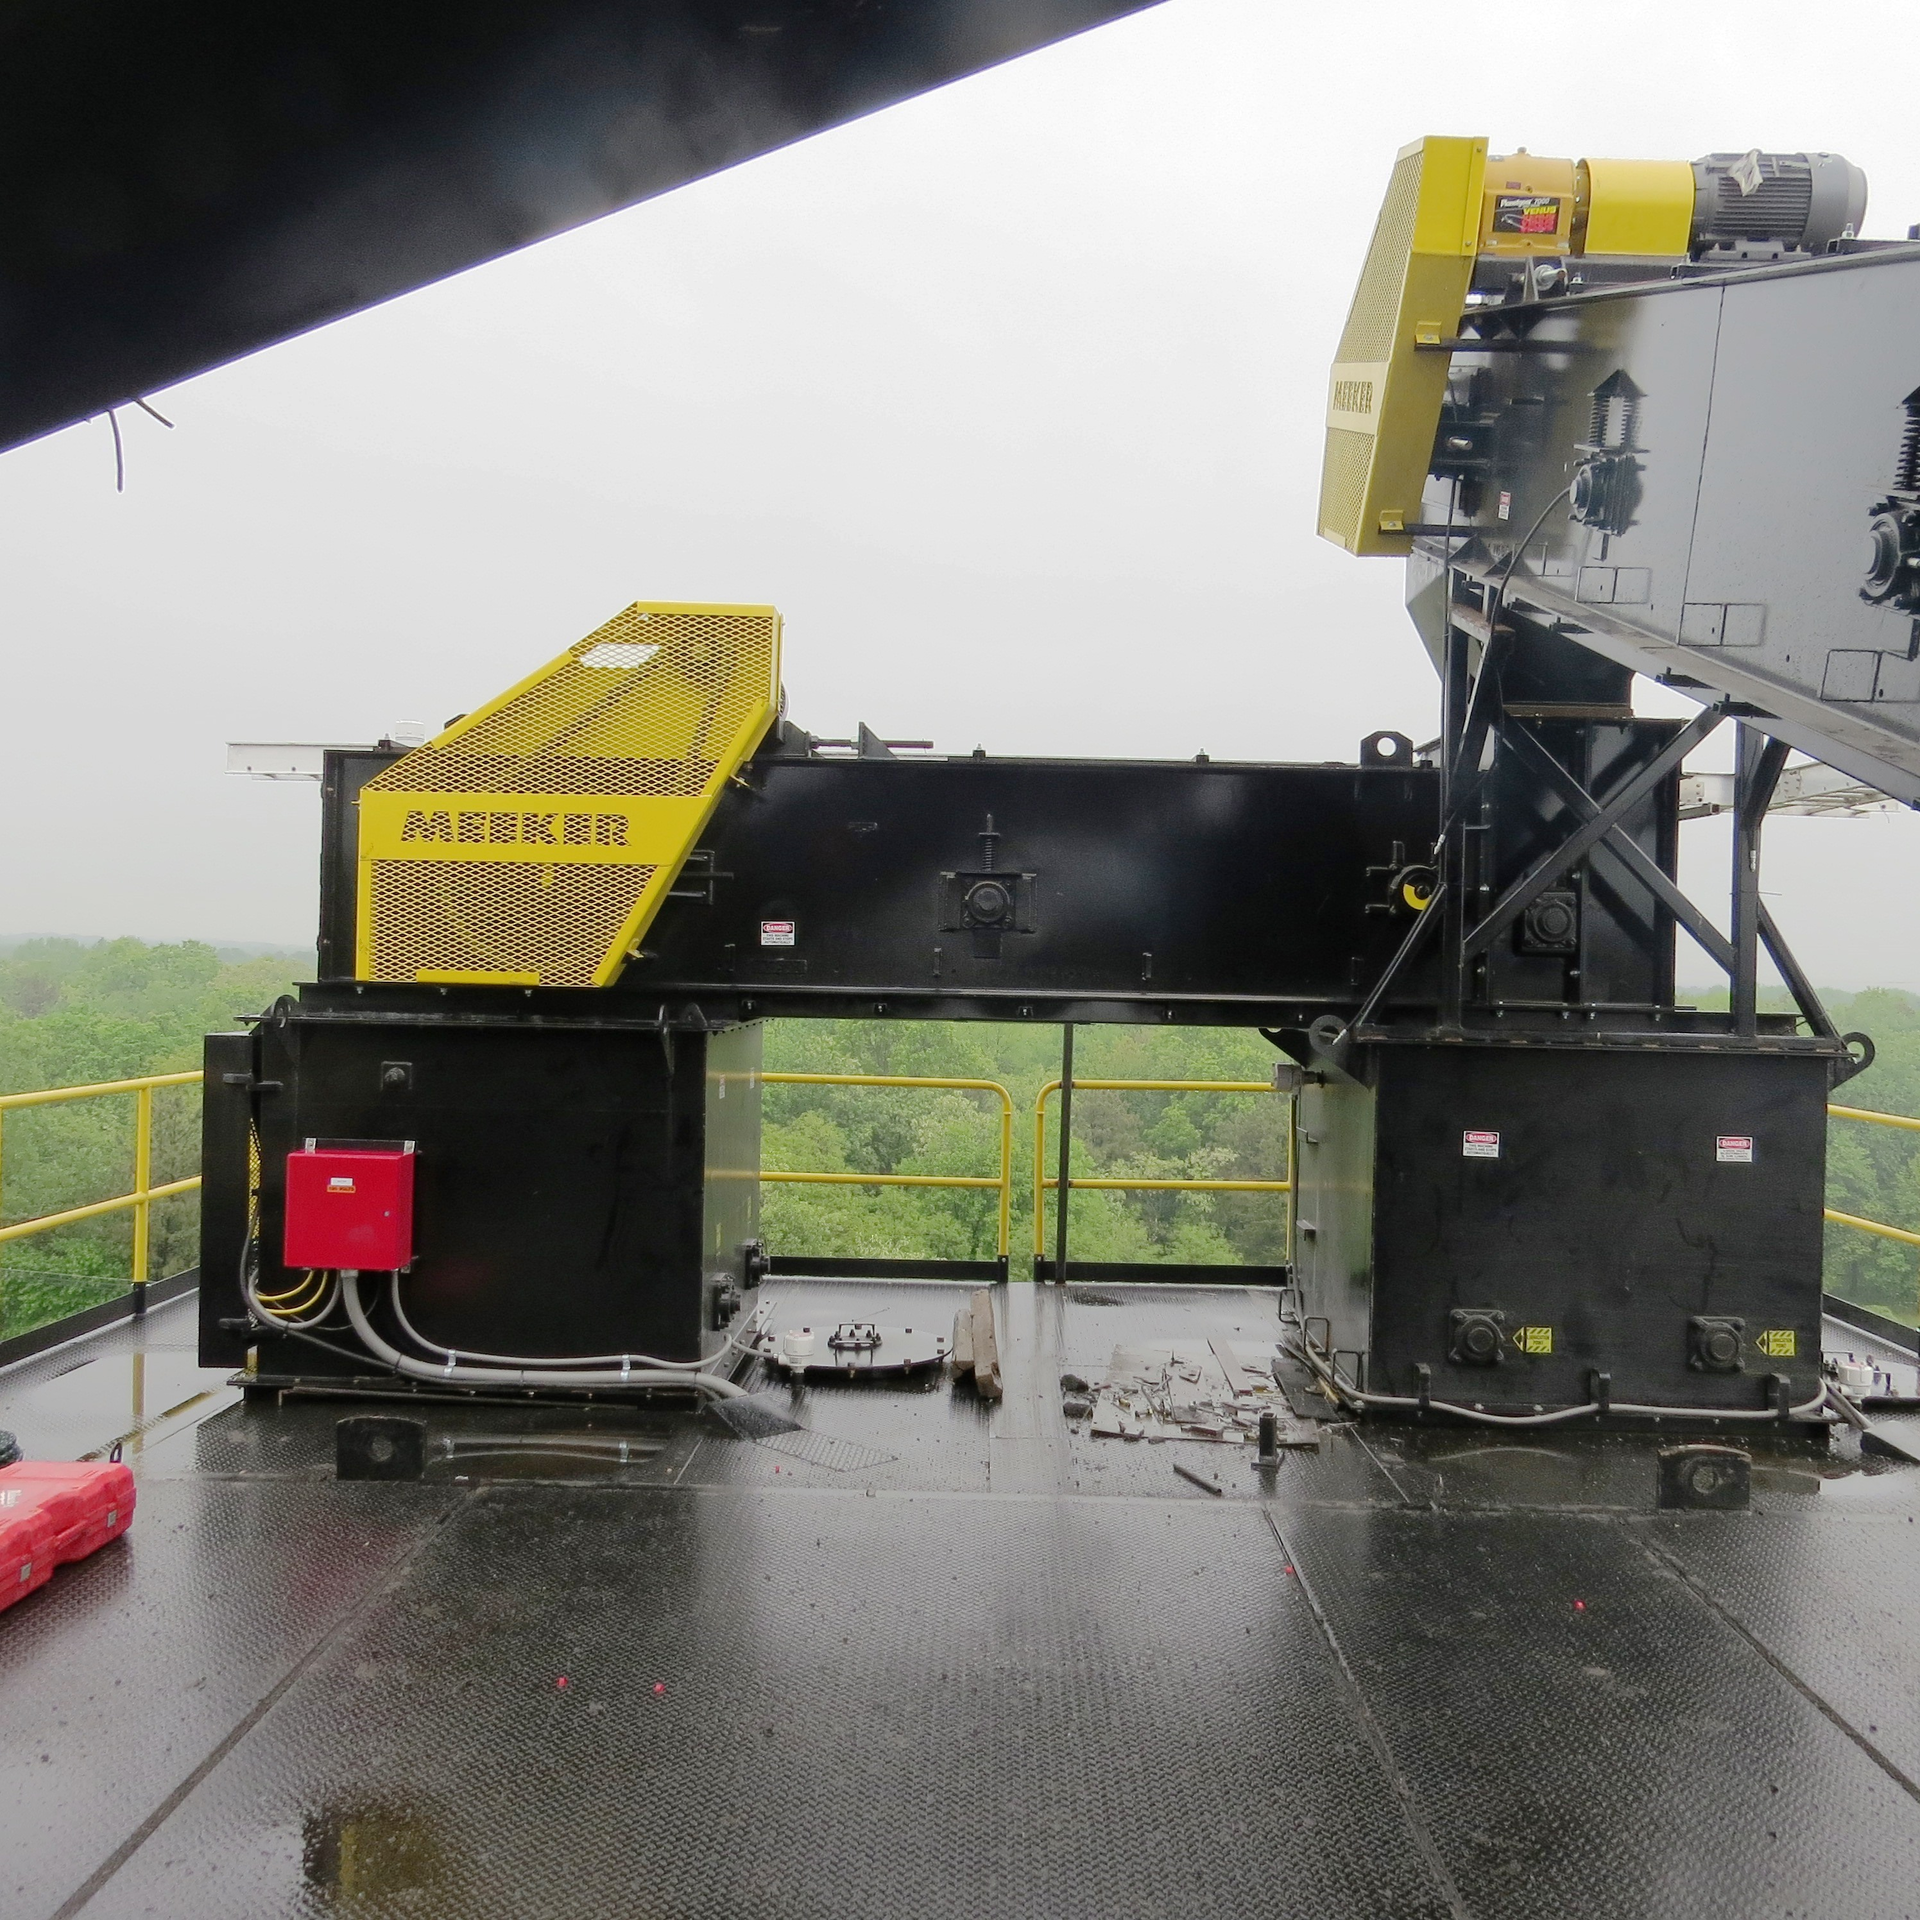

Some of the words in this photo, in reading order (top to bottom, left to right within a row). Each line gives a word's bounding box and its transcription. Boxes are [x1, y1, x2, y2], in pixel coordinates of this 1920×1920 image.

[1523, 206, 1557, 214] VENUS
[1333, 381, 1373, 414] MEEKER
[401, 810, 631, 846] MEEKER
